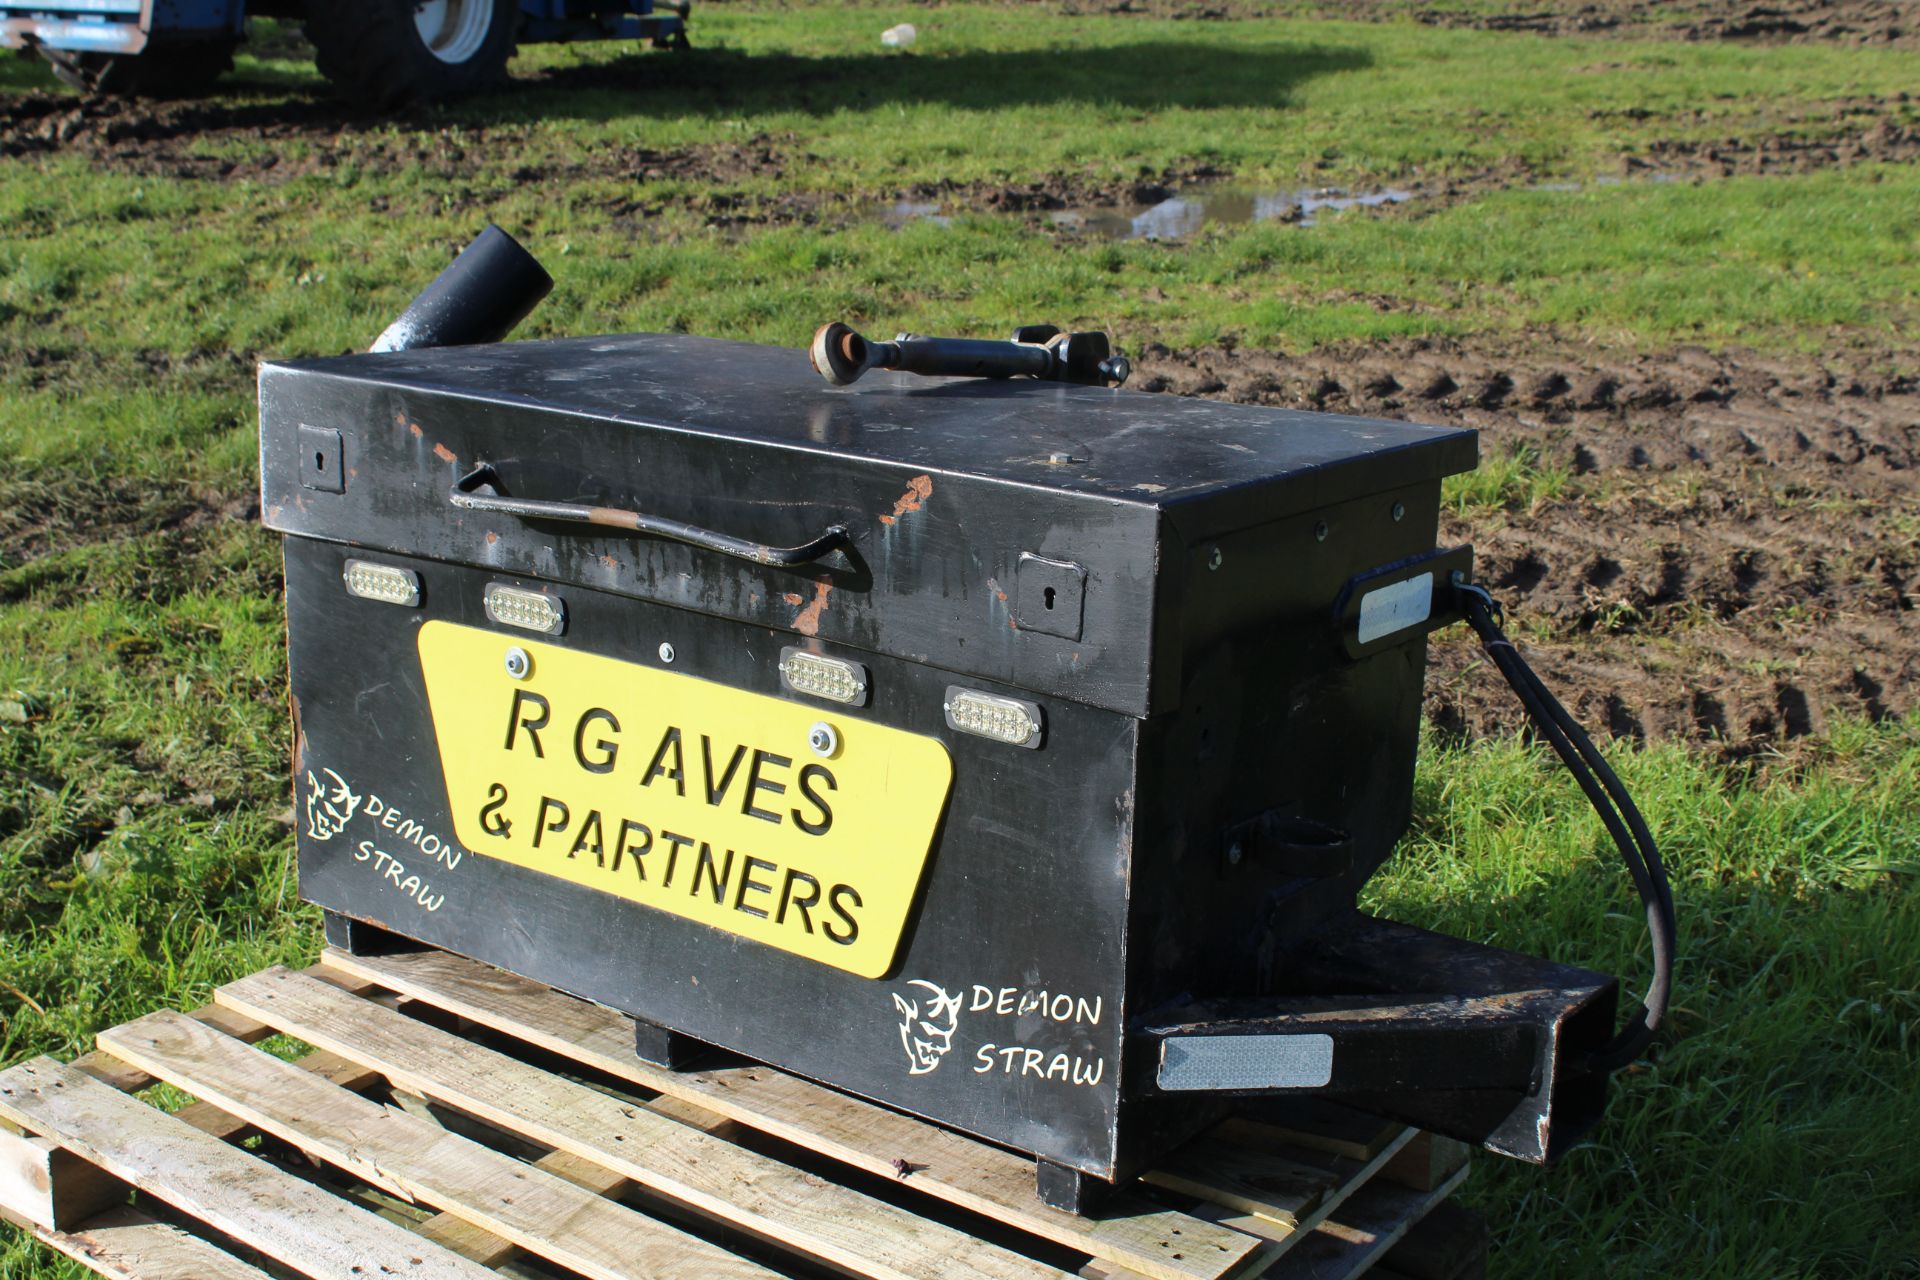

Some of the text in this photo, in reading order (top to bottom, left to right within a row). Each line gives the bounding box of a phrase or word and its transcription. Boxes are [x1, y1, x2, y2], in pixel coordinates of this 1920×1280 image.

[504, 688, 838, 836] R G AVES
[363, 794, 462, 871] DEMON
[479, 783, 864, 946] & PARTNERS
[354, 840, 445, 912] STRAW
[969, 984, 1102, 1025] DEMON
[973, 1043, 1104, 1086] STRAW
